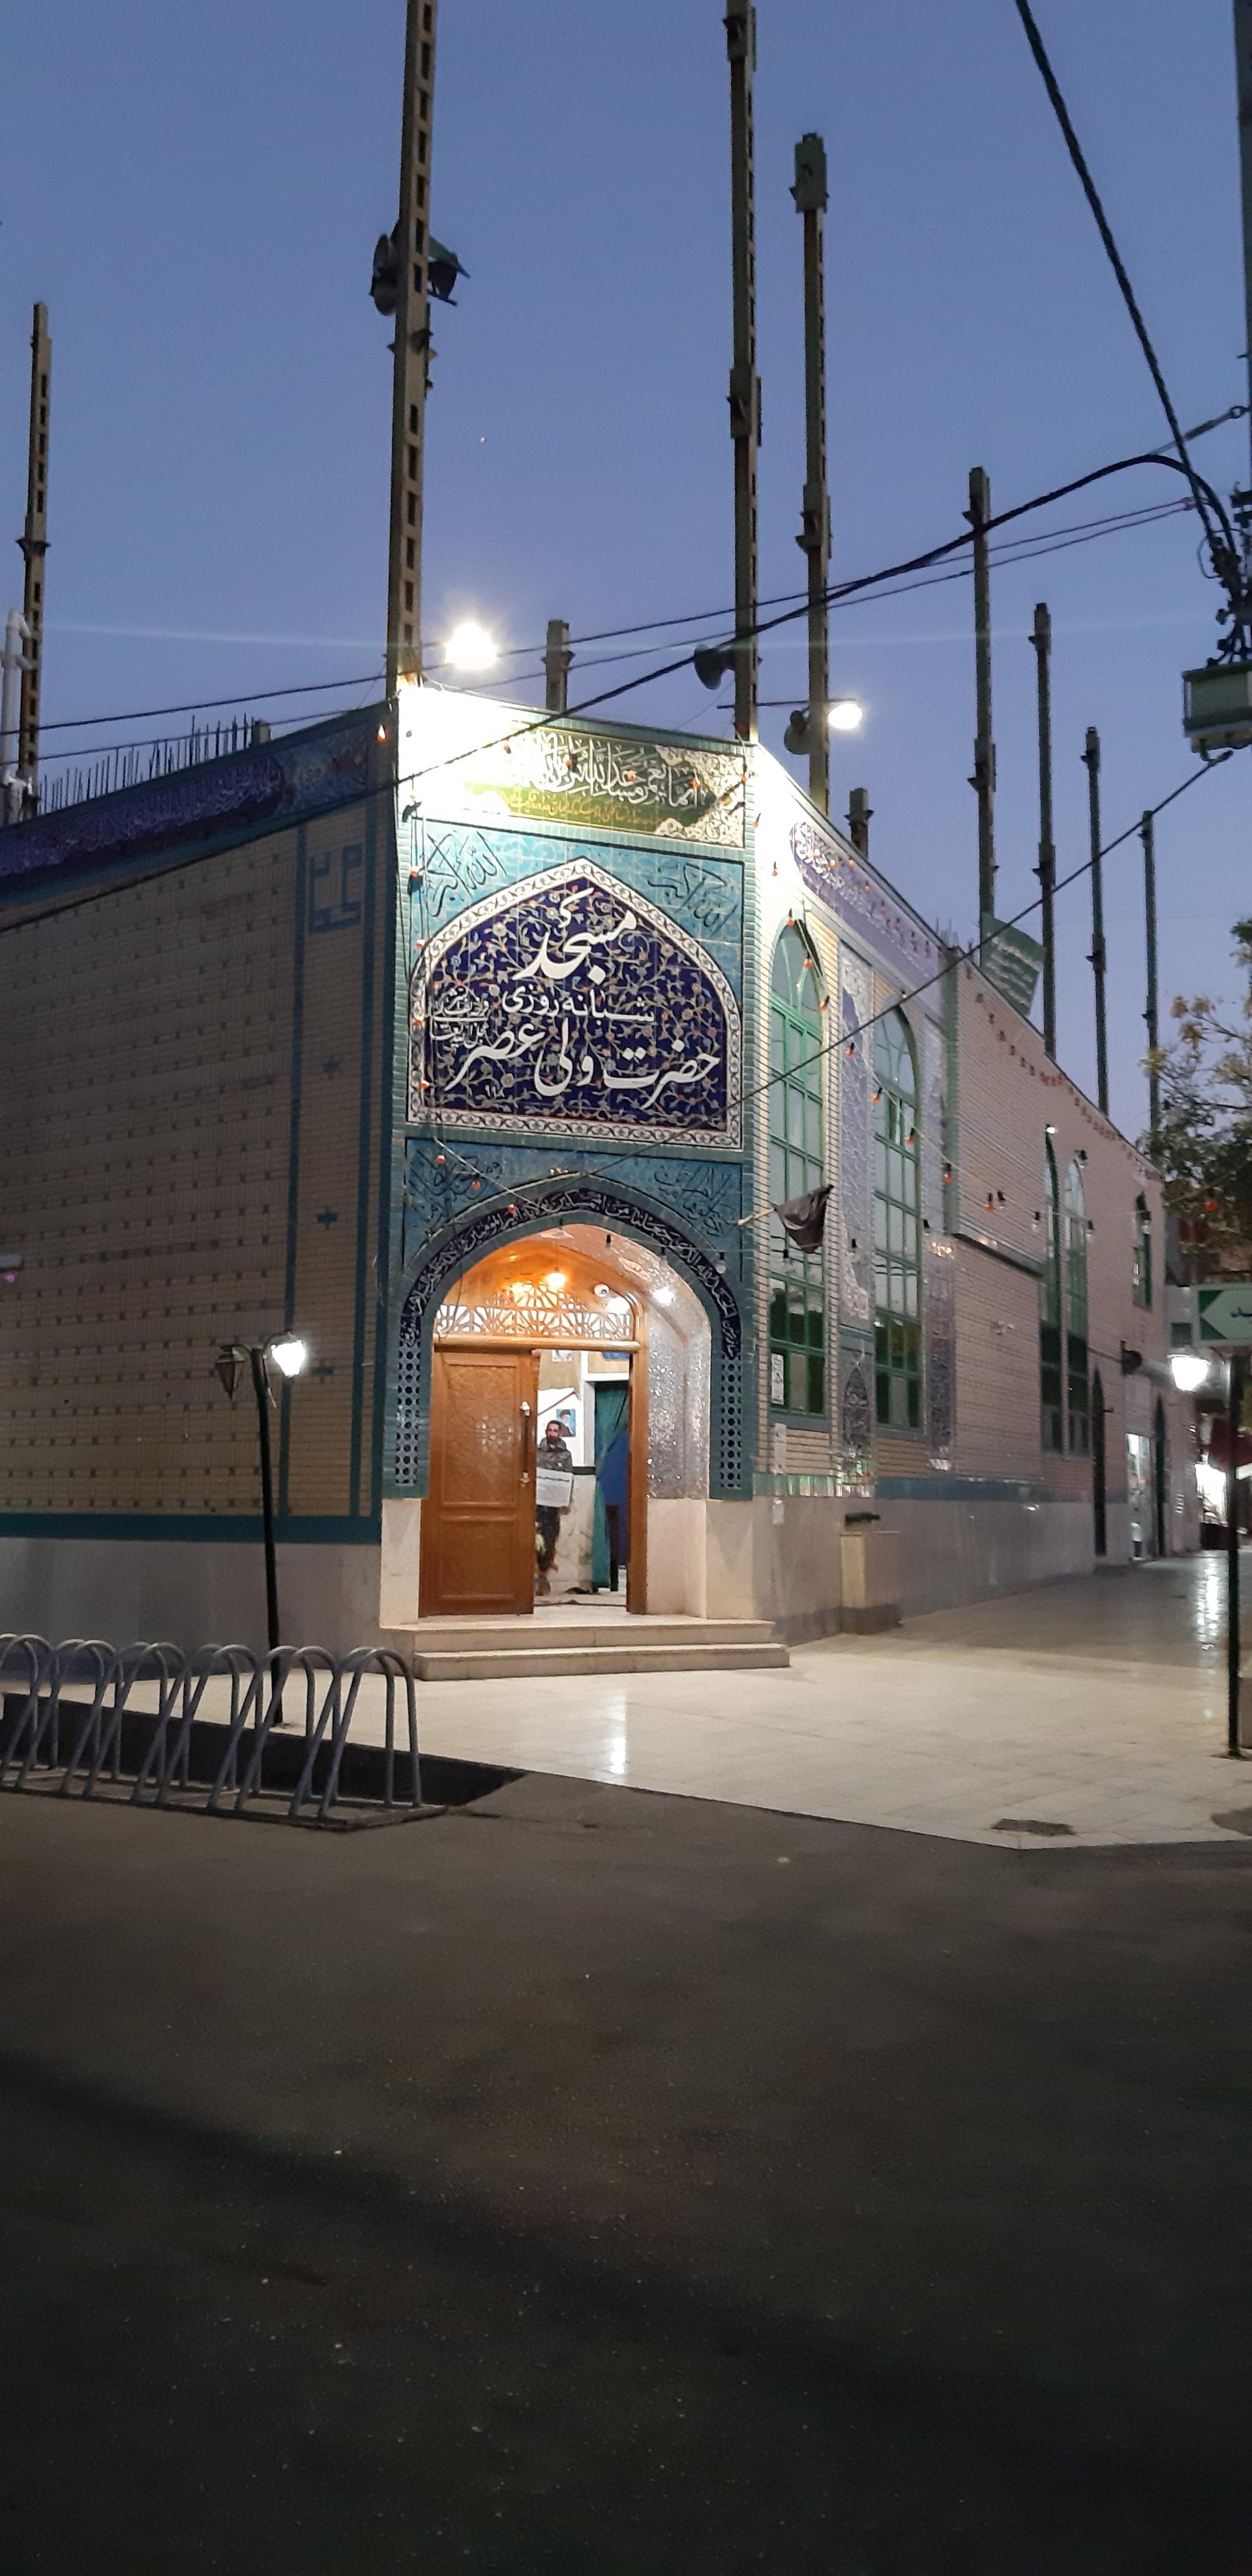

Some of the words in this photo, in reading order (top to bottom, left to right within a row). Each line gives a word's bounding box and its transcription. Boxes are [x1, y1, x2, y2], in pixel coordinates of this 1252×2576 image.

[512, 887, 637, 985] مسجد
[501, 983, 559, 1017] روزی
[561, 988, 655, 1026] شبانه
[443, 1022, 546, 1092] عصر
[533, 1017, 594, 1097] ولی
[603, 1039, 721, 1110] حضرت
